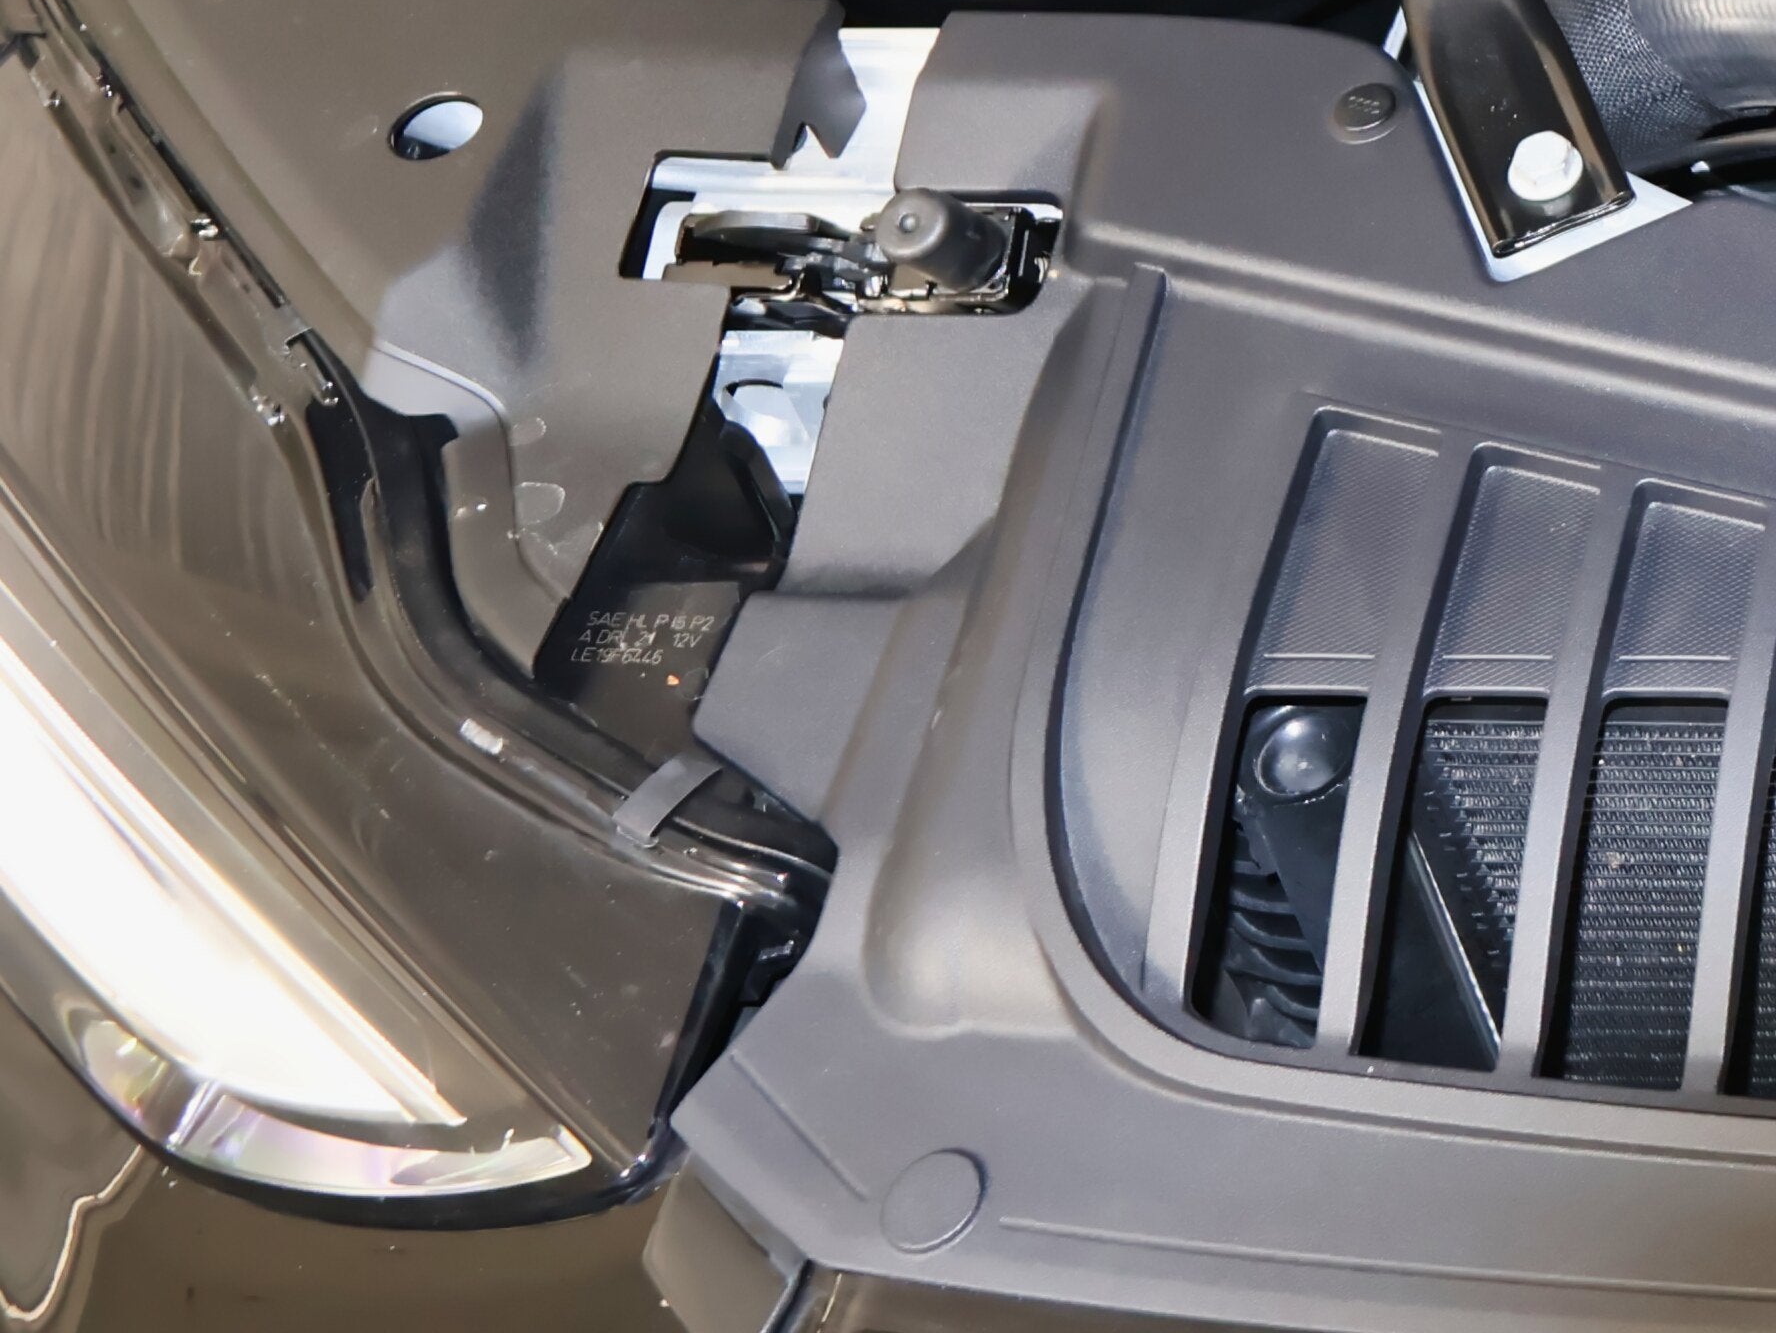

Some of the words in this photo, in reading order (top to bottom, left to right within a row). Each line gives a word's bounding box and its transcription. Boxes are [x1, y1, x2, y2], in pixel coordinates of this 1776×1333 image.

[587, 611, 626, 627] SAE
[654, 614, 669, 629] P
[689, 615, 715, 631] P2
[578, 629, 591, 642] A
[673, 633, 702, 648] 12V
